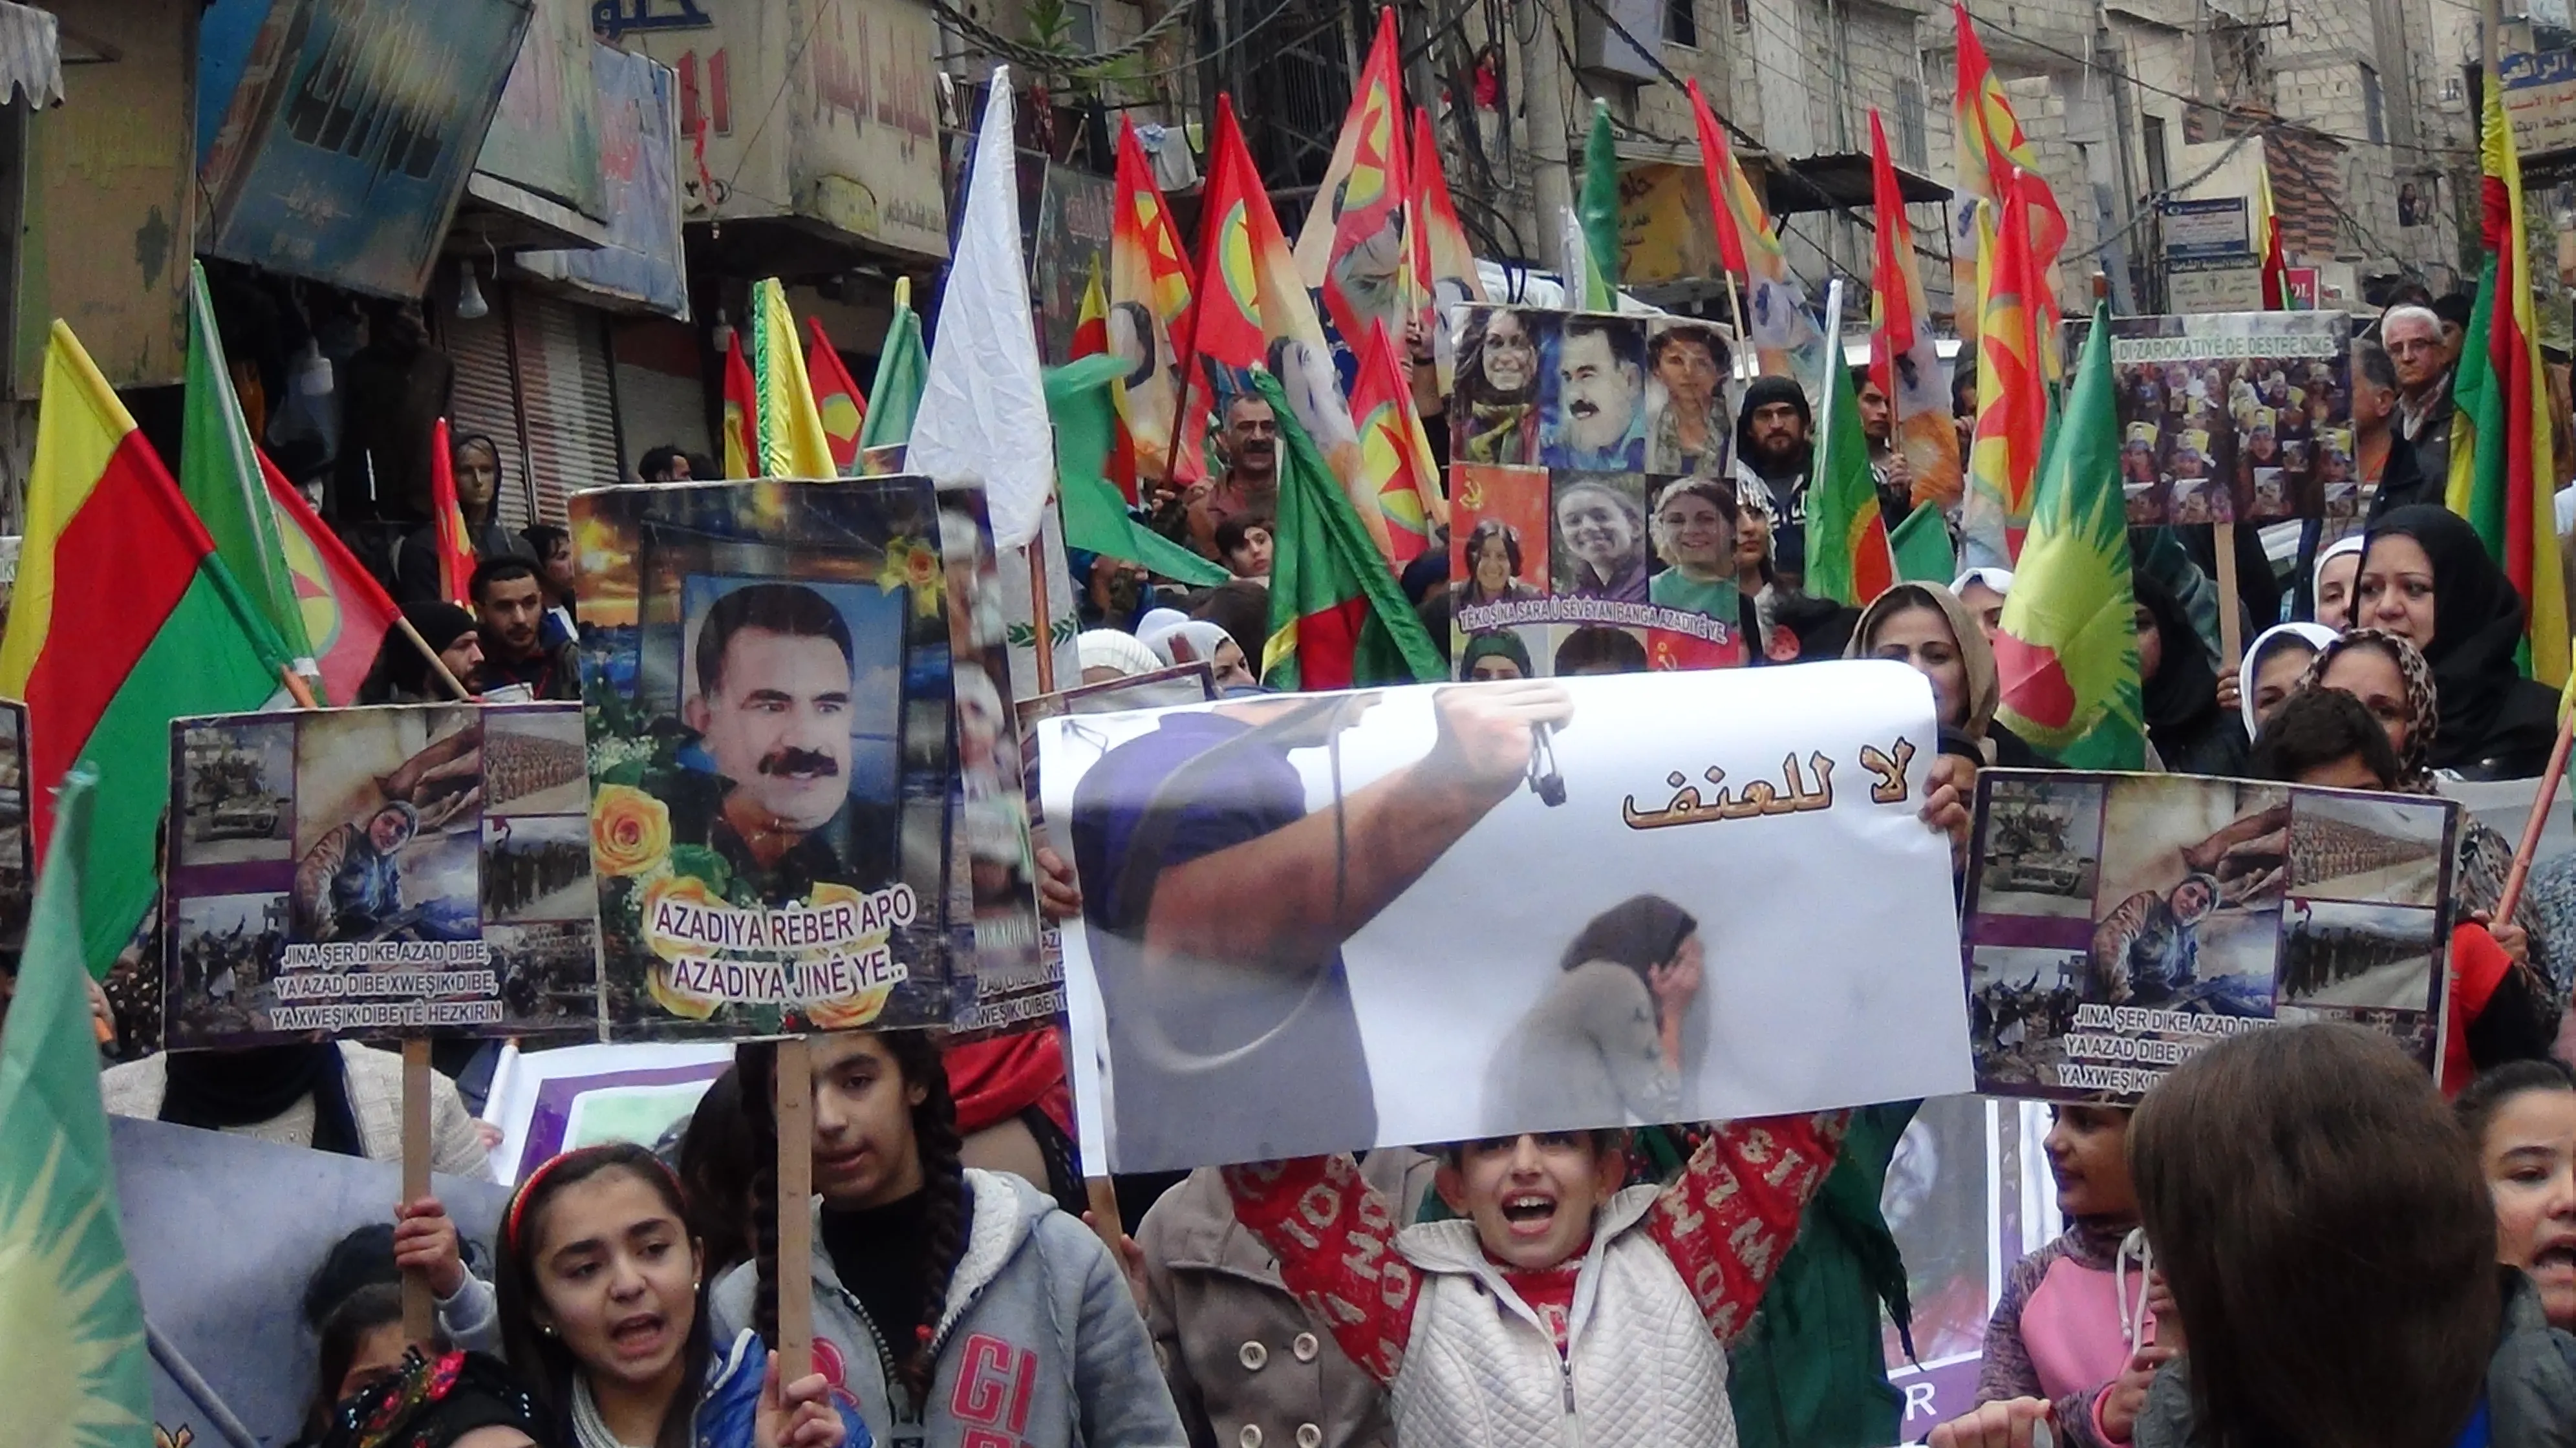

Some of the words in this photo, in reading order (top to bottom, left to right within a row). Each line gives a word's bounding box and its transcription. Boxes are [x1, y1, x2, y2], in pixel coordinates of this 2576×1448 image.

[1860, 736, 1916, 804] لا
[1622, 750, 1836, 830] للعنف
[656, 902, 764, 946] AZADIYA
[861, 888, 912, 935] APO
[283, 946, 318, 965] JINA
[359, 944, 396, 962] DIKE
[401, 944, 444, 961] AZAD
[277, 979, 298, 996] YA
[301, 977, 343, 994] AZAD
[349, 975, 385, 993] DIBE
[674, 959, 786, 998] AZADIYA
[791, 953, 848, 998] JINÊ
[273, 1010, 293, 1027] YA
[362, 1006, 399, 1023] DIBE
[429, 1002, 501, 1021] HEZKIRIN
[2076, 1006, 2111, 1025] JINA
[2152, 1012, 2189, 1031] DIKE
[2193, 1017, 2236, 1034] AZAD
[2067, 1036, 2087, 1054] YA
[2090, 1039, 2134, 1058] AZAD
[2140, 1040, 2176, 1061] DIBE
[2060, 1067, 2081, 1084] YA
